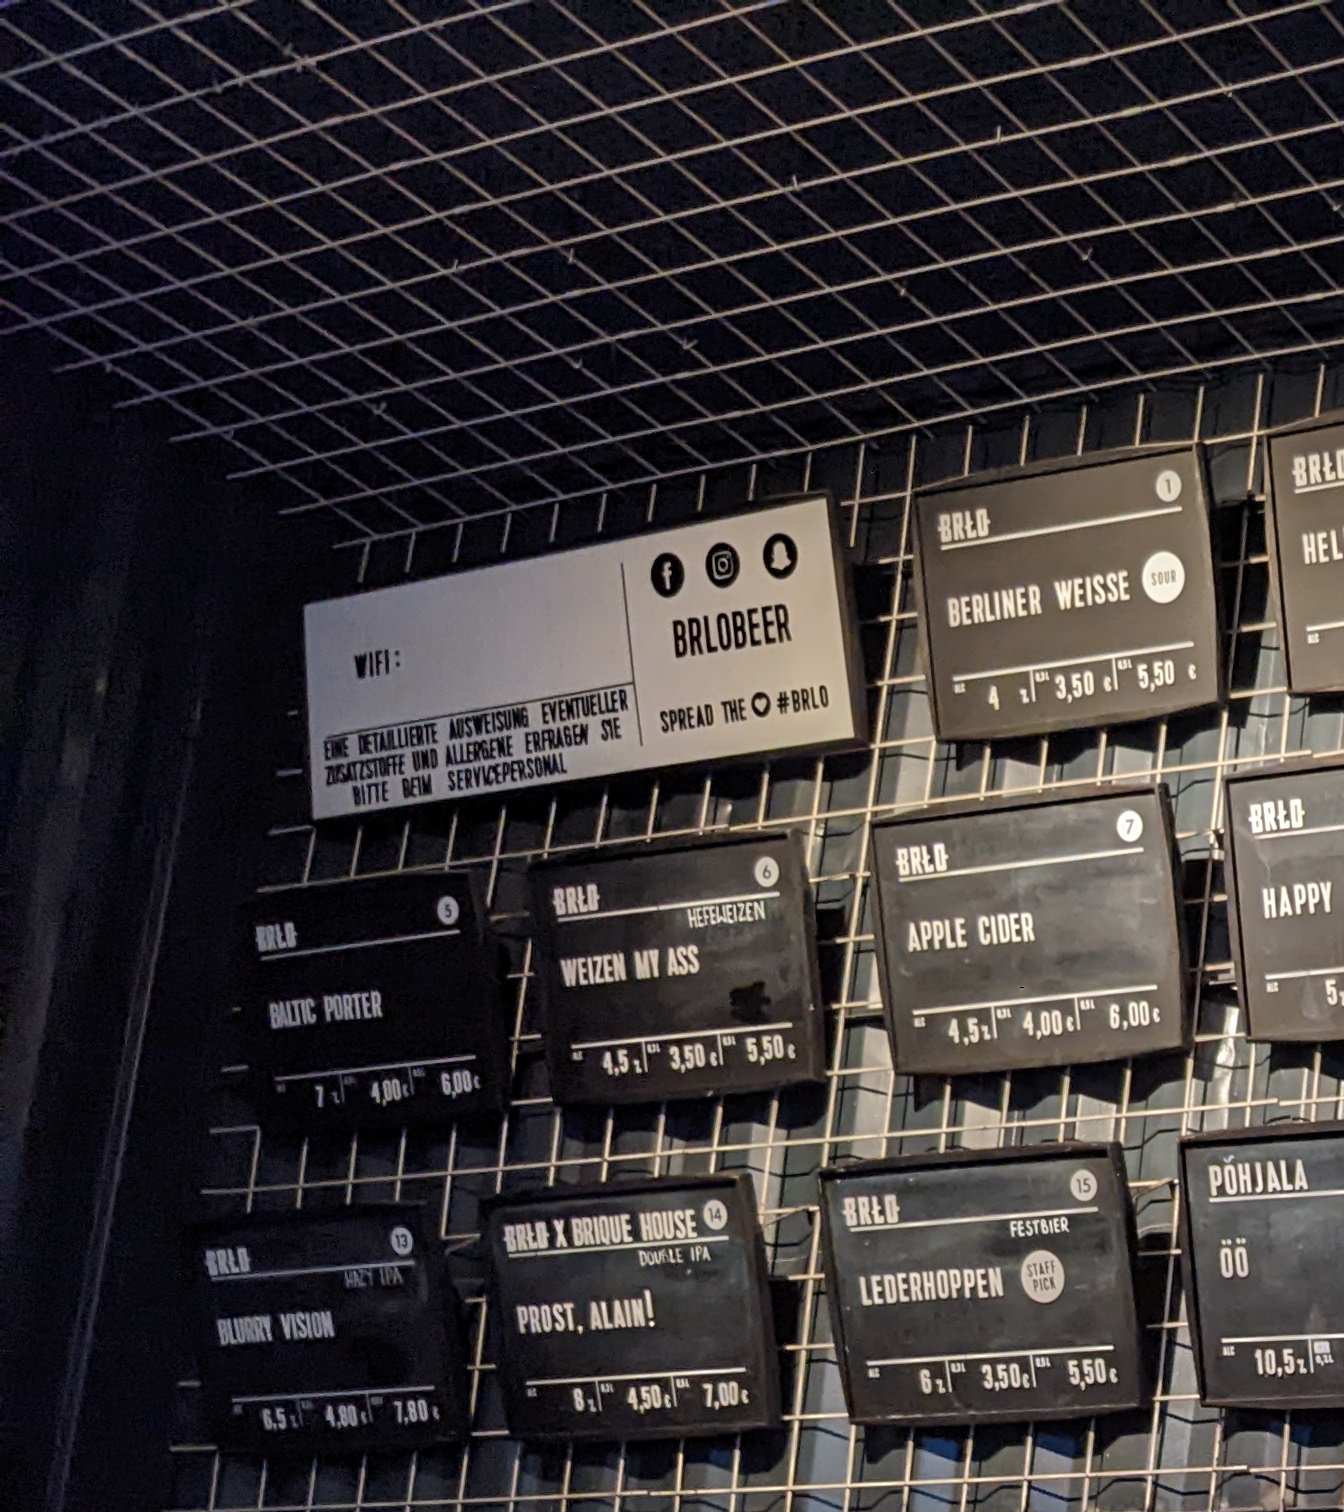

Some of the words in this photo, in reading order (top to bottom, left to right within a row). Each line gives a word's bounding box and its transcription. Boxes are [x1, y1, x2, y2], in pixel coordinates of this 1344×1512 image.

[1150, 570, 1177, 586] SOUR
[948, 585, 1042, 627] BERLINER
[1054, 571, 1130, 610] WEISSE
[671, 603, 793, 659] BRLOBEER
[324, 736, 350, 762] EINE
[358, 723, 438, 756] DETAILLIERTE
[449, 708, 529, 741] AUSWEISUNG
[541, 690, 628, 722] EVENTUELLER
[659, 703, 715, 733] SPREAD
[722, 698, 747, 722] THE
[776, 685, 829, 716] #BRLO
[325, 756, 406, 786] ZUSATZSTOFFE
[413, 743, 438, 772] UND
[446, 733, 514, 768] ALLERGENE
[524, 724, 588, 752] ERFRAGEN
[601, 719, 621, 742] SIE
[353, 783, 389, 807] BITTE
[402, 775, 433, 799] BEIM
[447, 756, 567, 794] SERVICEPERSONAL
[688, 900, 766, 929] HEFEWEIZEN
[1263, 881, 1332, 920] HAPPY
[908, 918, 968, 953] APPLE
[977, 912, 1035, 946] CIDER
[560, 951, 627, 988] WEIZEN
[634, 949, 660, 980] MY
[667, 945, 699, 977] ASS
[269, 998, 317, 1030] BALTIC
[323, 989, 384, 1023] PORTER
[1076, 1178, 1092, 1193] 15
[554, 1219, 568, 1248] X
[572, 1214, 633, 1247] BRIQUE
[639, 1209, 698, 1241] HOUSE
[708, 1208, 722, 1221] 14
[1010, 1217, 1070, 1238] FESTBIER
[691, 1246, 711, 1262] IPA
[1027, 1260, 1056, 1277] STAFF
[1220, 1237, 1250, 1279] ÖÖ
[859, 1267, 1004, 1307] LEDERHOPPEN
[1033, 1277, 1057, 1293] PICK
[217, 1315, 273, 1347] BLURRY
[280, 1310, 335, 1340] VISION
[516, 1303, 583, 1334] PROST,
[590, 1289, 655, 1331] ALAIN!
